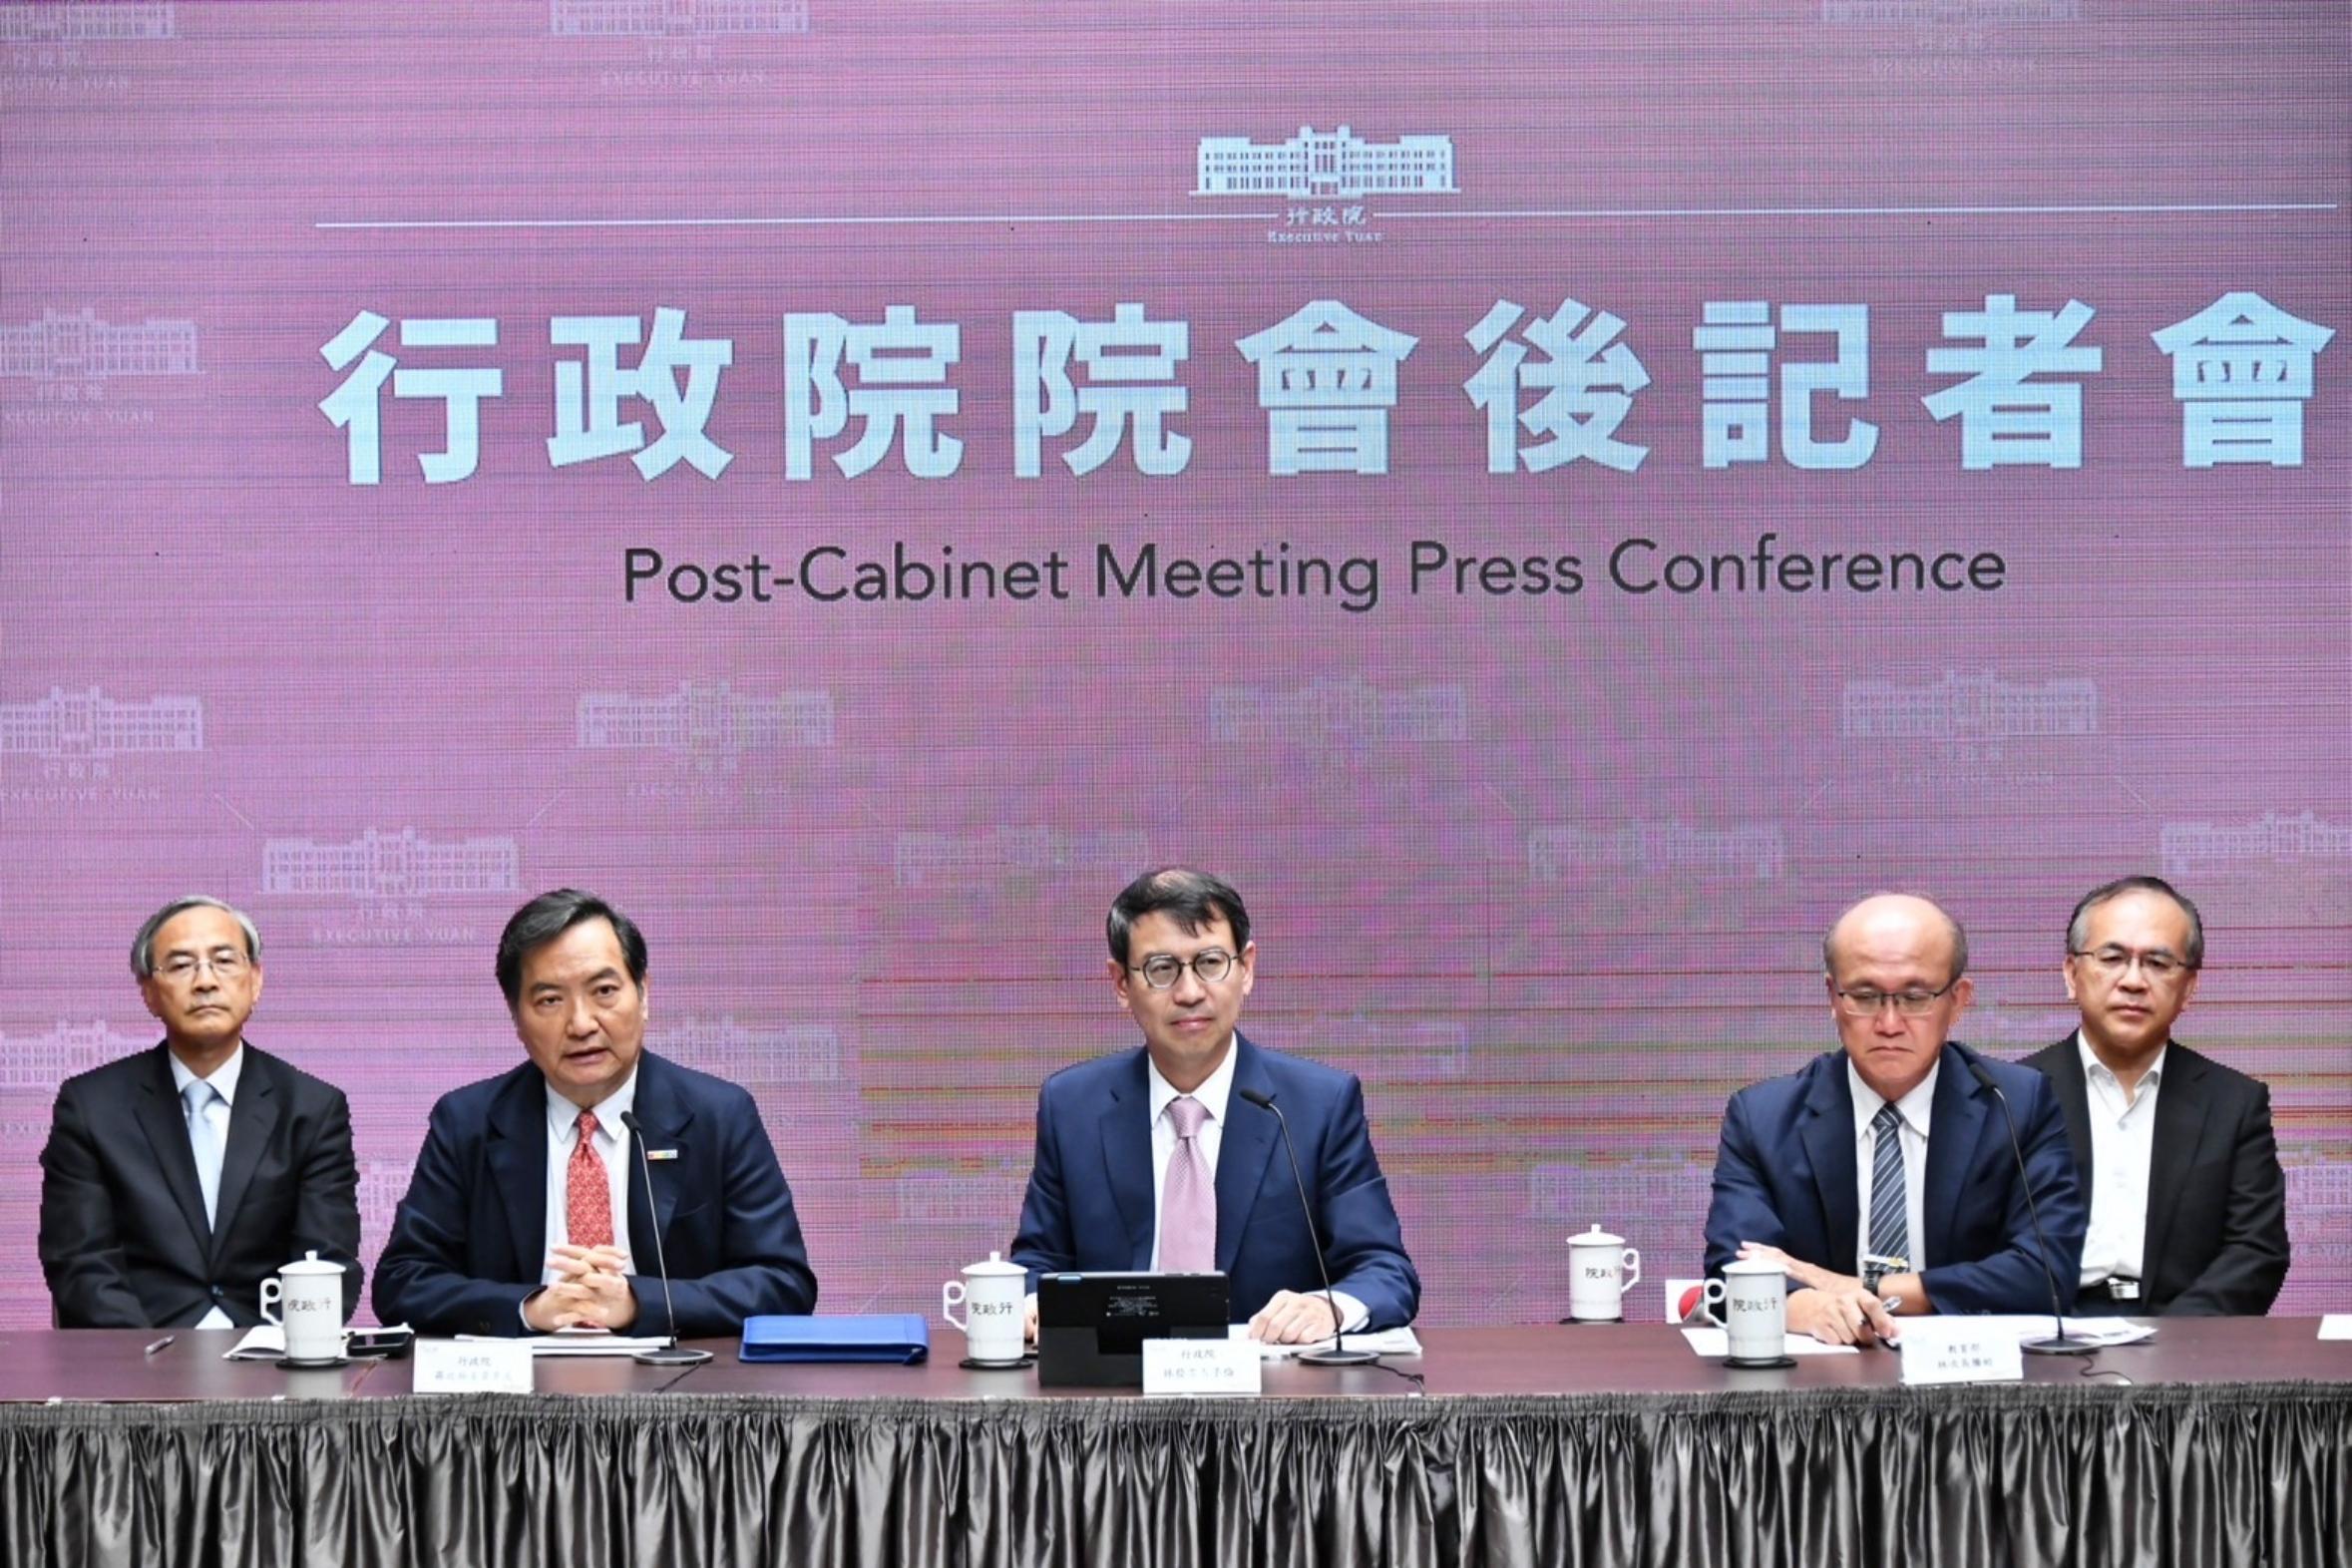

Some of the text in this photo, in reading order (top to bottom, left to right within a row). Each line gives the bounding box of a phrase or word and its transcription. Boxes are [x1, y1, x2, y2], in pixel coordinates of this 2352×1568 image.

[1268, 230, 1340, 243] Executive
[1287, 205, 1367, 224] 行政院
[318, 290, 2337, 486] 行政院院會後記者會
[624, 534, 2007, 612] Post-Cabinet Meeting Press Conference
